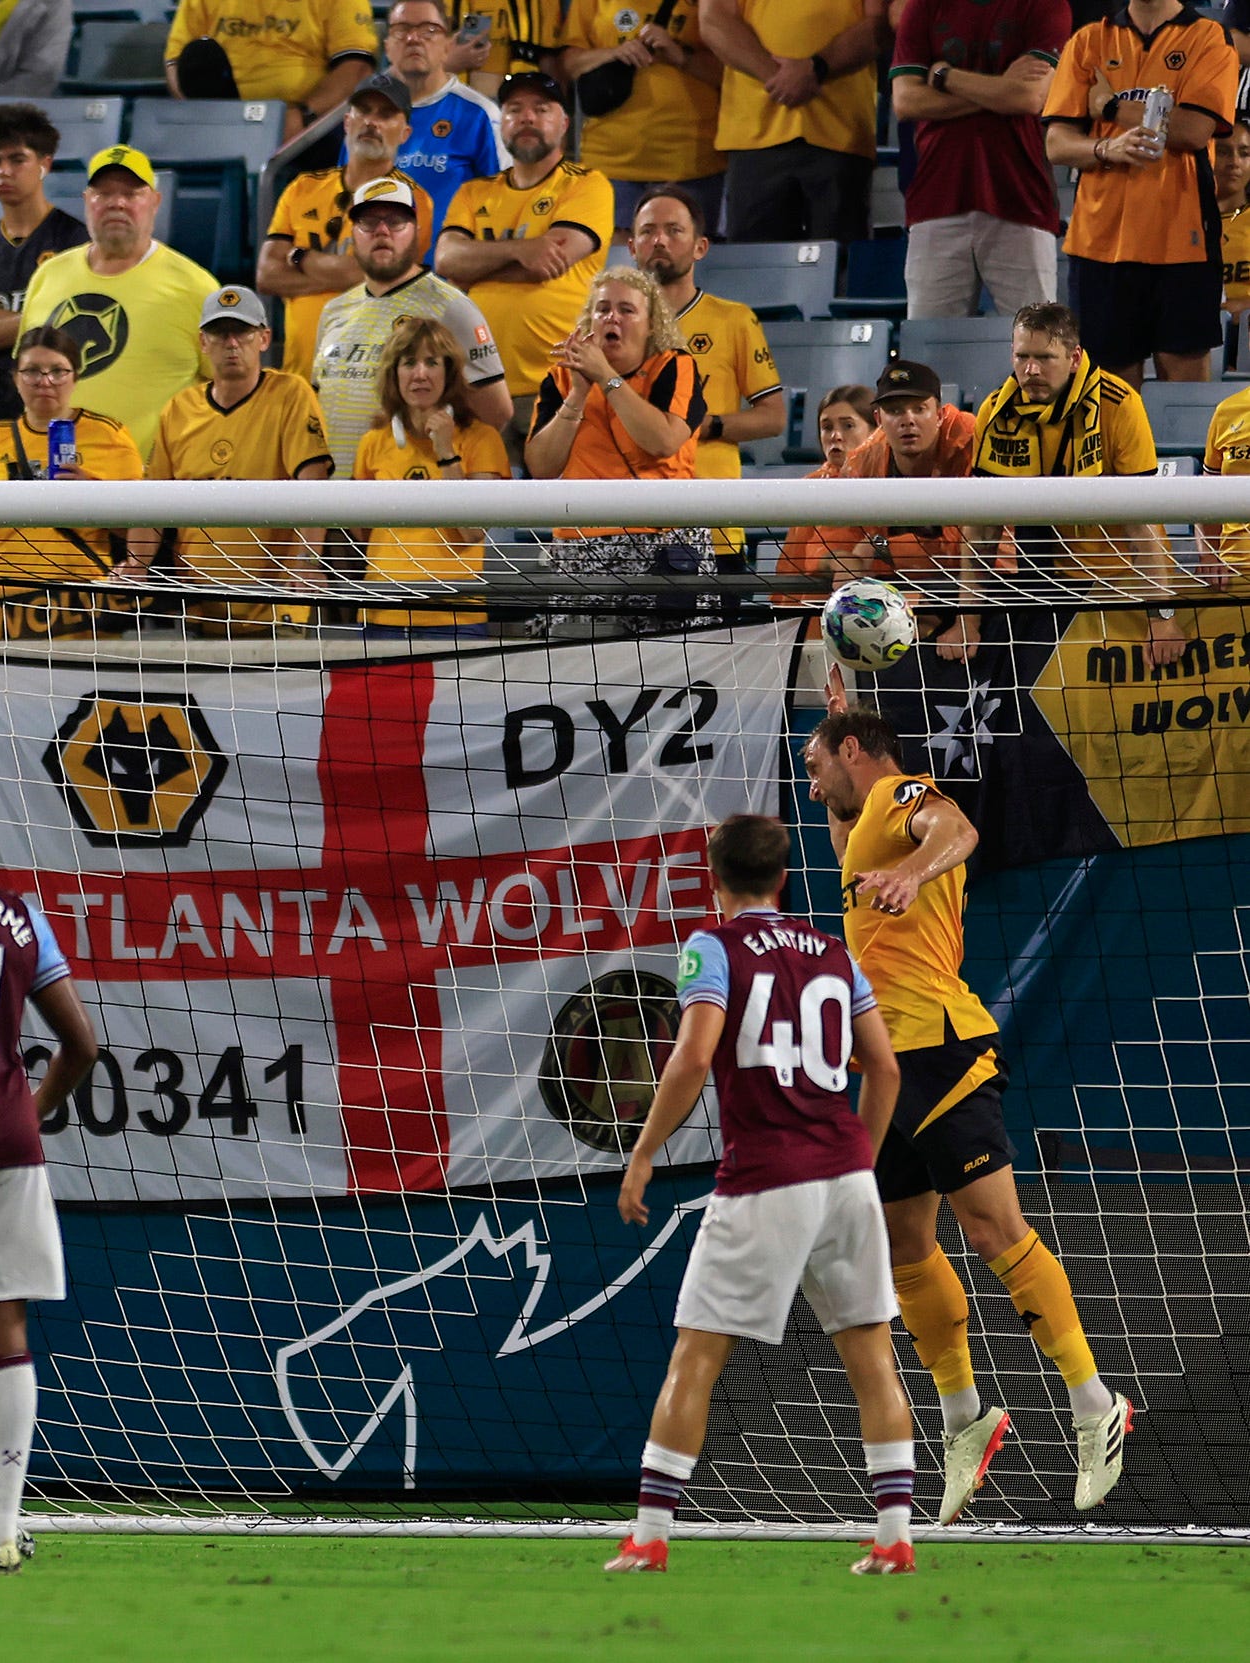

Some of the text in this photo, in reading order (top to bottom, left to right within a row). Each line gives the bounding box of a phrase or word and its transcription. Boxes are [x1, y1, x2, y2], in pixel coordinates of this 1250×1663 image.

[501, 680, 719, 790] DY2
[24, 851, 707, 960] TLANTA WOLVE
[743, 927, 828, 957] EARTHY
[736, 970, 854, 1093] 40
[963, 1152, 991, 1173] SUDU
